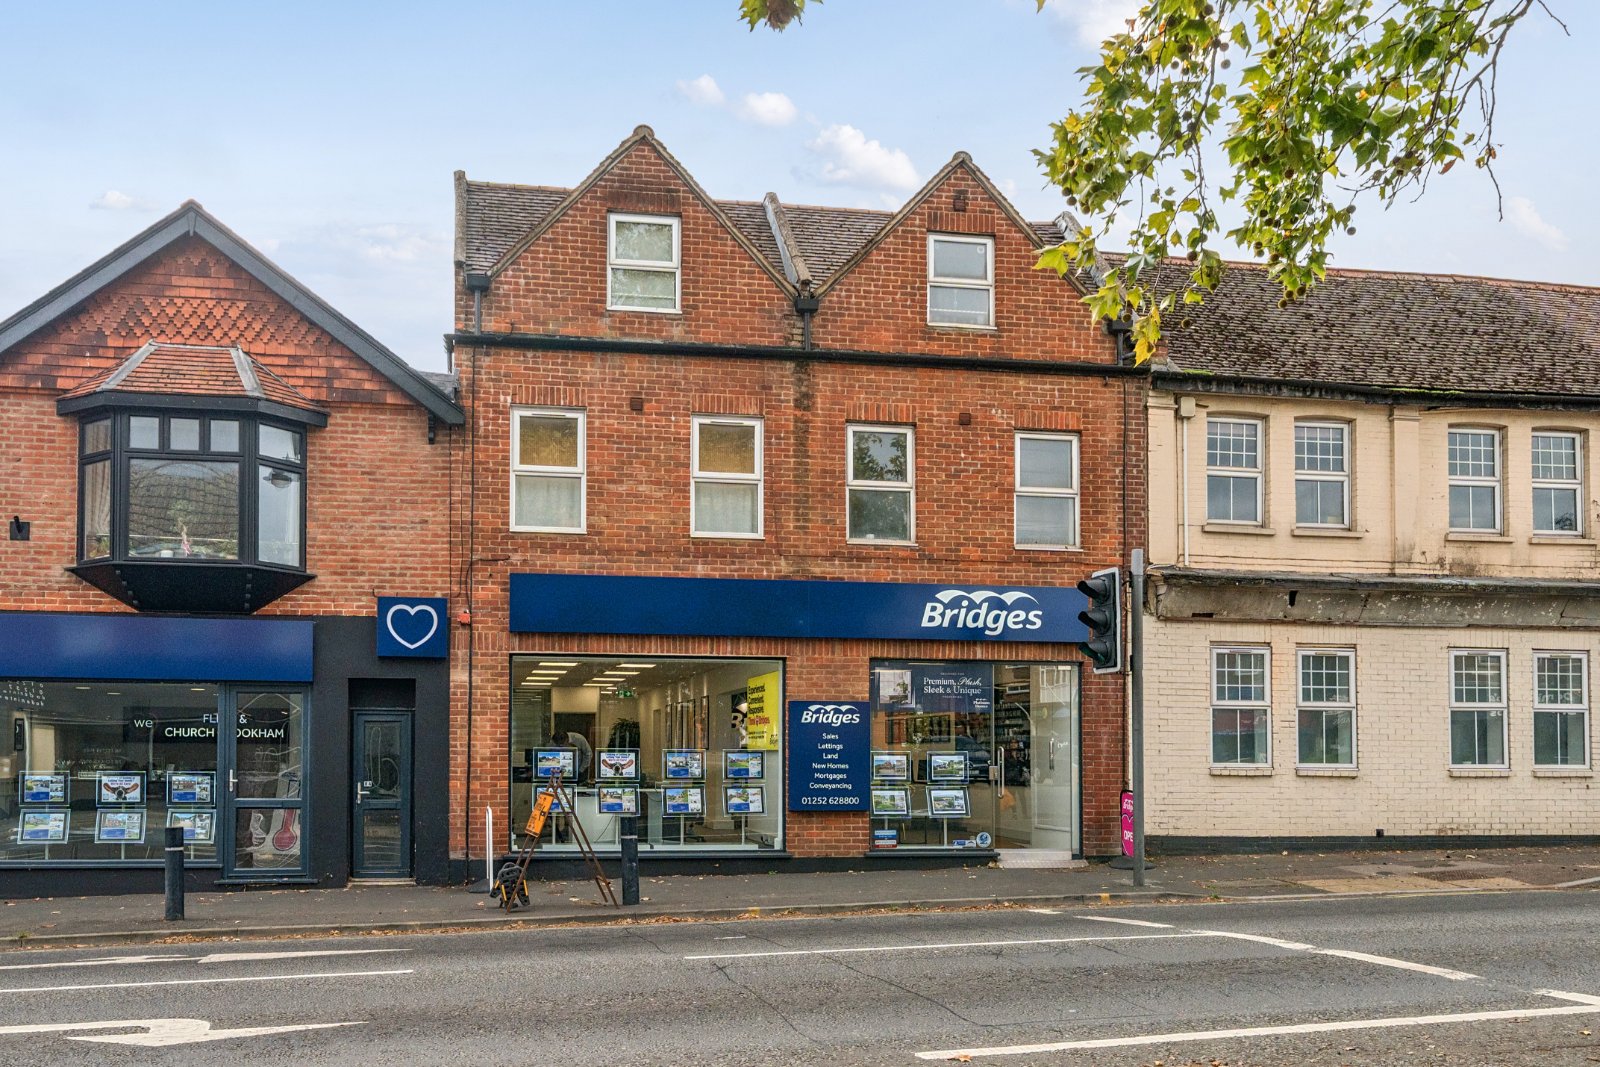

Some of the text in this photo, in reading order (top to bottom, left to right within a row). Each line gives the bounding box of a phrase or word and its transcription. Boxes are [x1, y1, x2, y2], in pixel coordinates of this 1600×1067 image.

[921, 600, 1043, 636] Bridges
[923, 676, 982, 686] Premium, Plush,
[923, 685, 945, 694] Sleek
[953, 685, 982, 696] Unique
[134, 719, 153, 728] we
[239, 714, 248, 724] &
[801, 709, 861, 727] Bridges
[164, 727, 215, 738] CHURCH
[801, 797, 860, 805] 01252 628800
[1123, 830, 1134, 842] OPE
